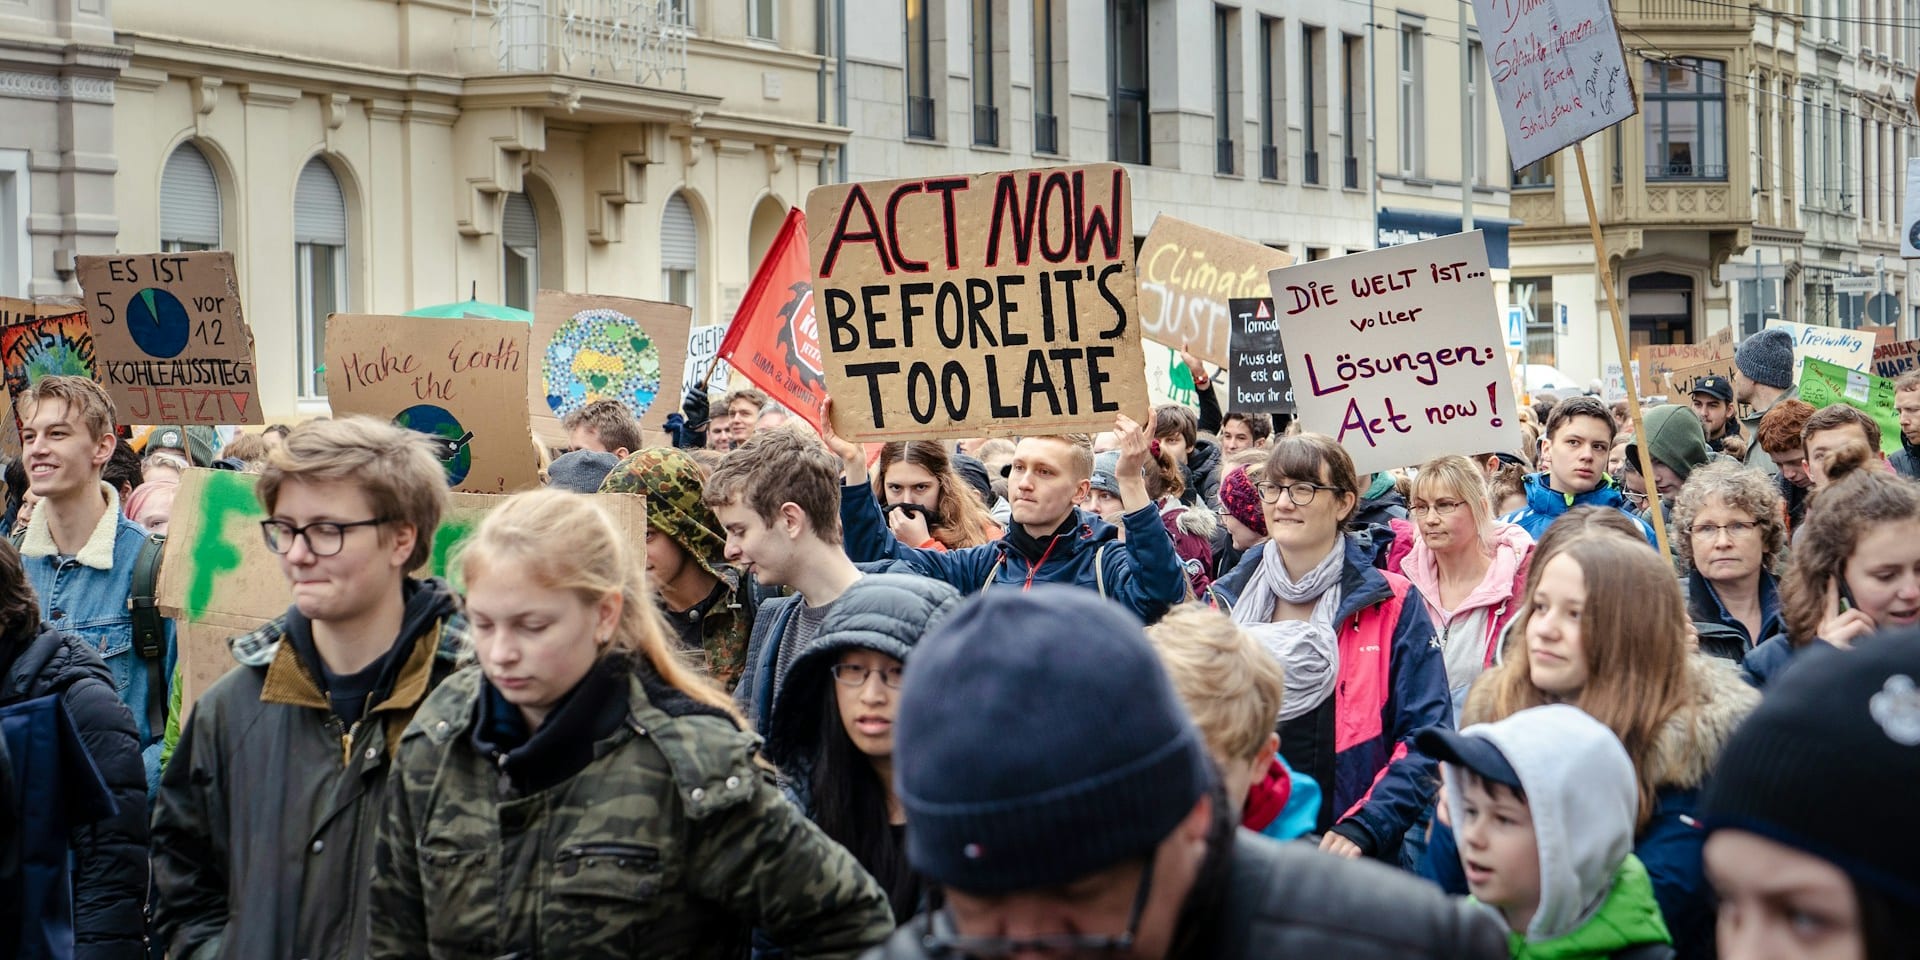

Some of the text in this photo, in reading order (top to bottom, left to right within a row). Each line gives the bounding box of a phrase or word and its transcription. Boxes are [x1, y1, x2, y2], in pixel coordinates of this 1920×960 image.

[819, 168, 1123, 278] ACT NOW
[108, 257, 189, 283] ES IST
[1351, 268, 1417, 298] WELT
[96, 291, 115, 324] 5
[824, 275, 1029, 353] BEFORE
[1039, 263, 1128, 343] IT'S
[1141, 282, 1227, 356] JUST
[1238, 310, 1280, 334] Tornad
[6, 321, 56, 366] THIS
[195, 319, 225, 346] 12
[107, 360, 251, 387] KOHLEAUSSTIEG
[340, 338, 520, 392] Make Earth
[1238, 350, 1283, 367] Muss der
[1250, 368, 1285, 382] erst an
[1304, 346, 1495, 397] Lösungen:
[411, 371, 457, 401] the
[752, 351, 817, 407] KLIMA & ZUKUNFT
[845, 346, 1120, 429] TOO LATE
[1237, 386, 1265, 404] bevor
[1268, 387, 1280, 402] ihr
[128, 387, 250, 423] JETZT!
[1336, 397, 1412, 448] Act
